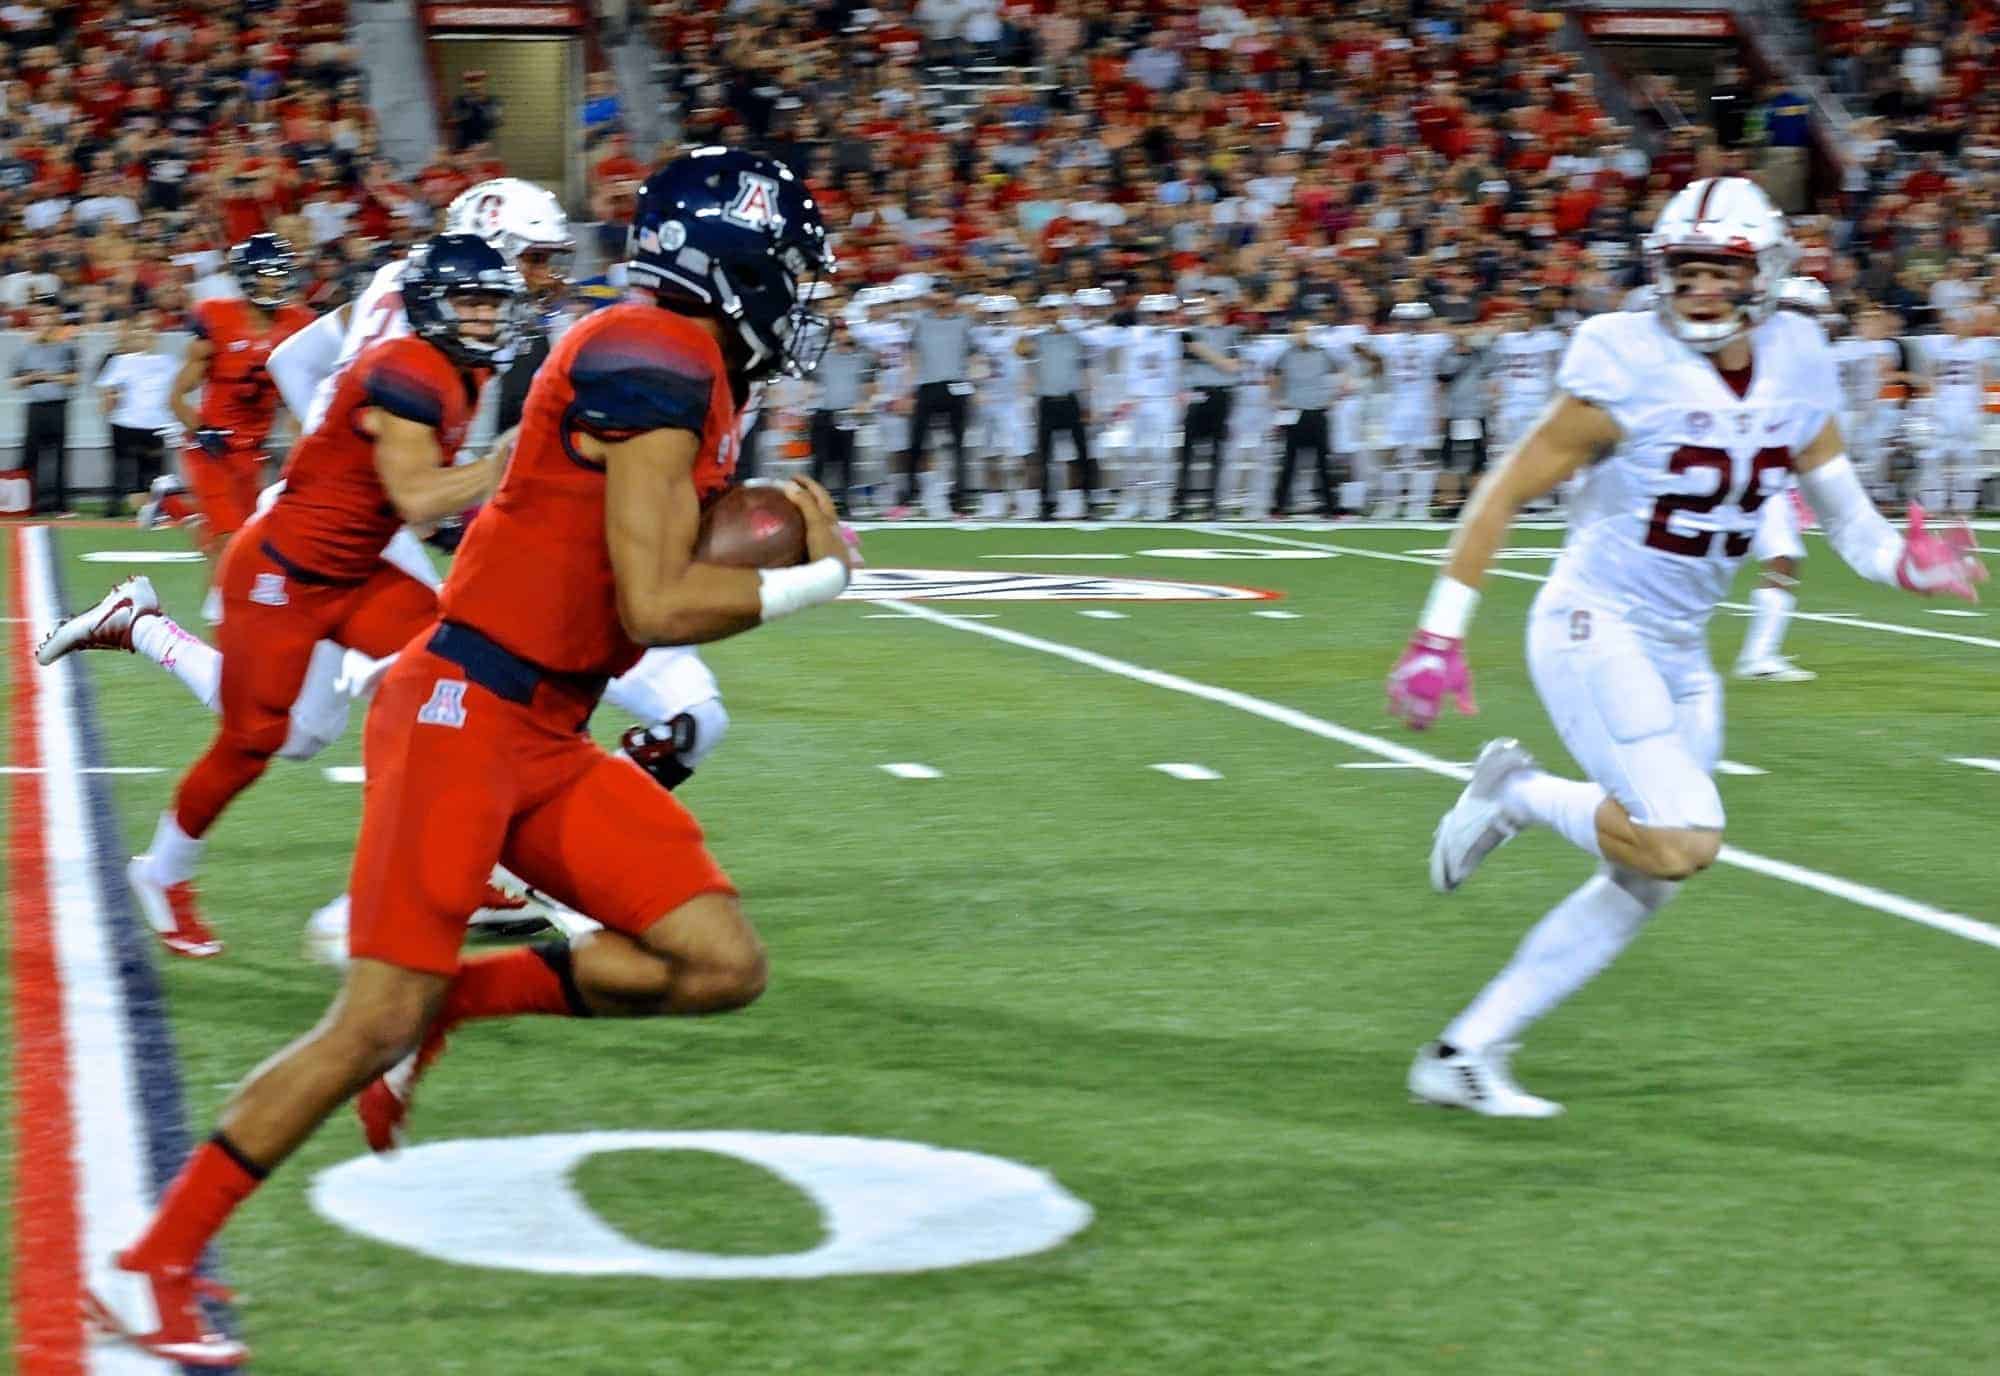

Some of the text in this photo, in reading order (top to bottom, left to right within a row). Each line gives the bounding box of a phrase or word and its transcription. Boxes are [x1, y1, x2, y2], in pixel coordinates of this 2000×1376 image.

[722, 171, 787, 238] A
[1570, 610, 1592, 641] S
[417, 678, 467, 729] A
